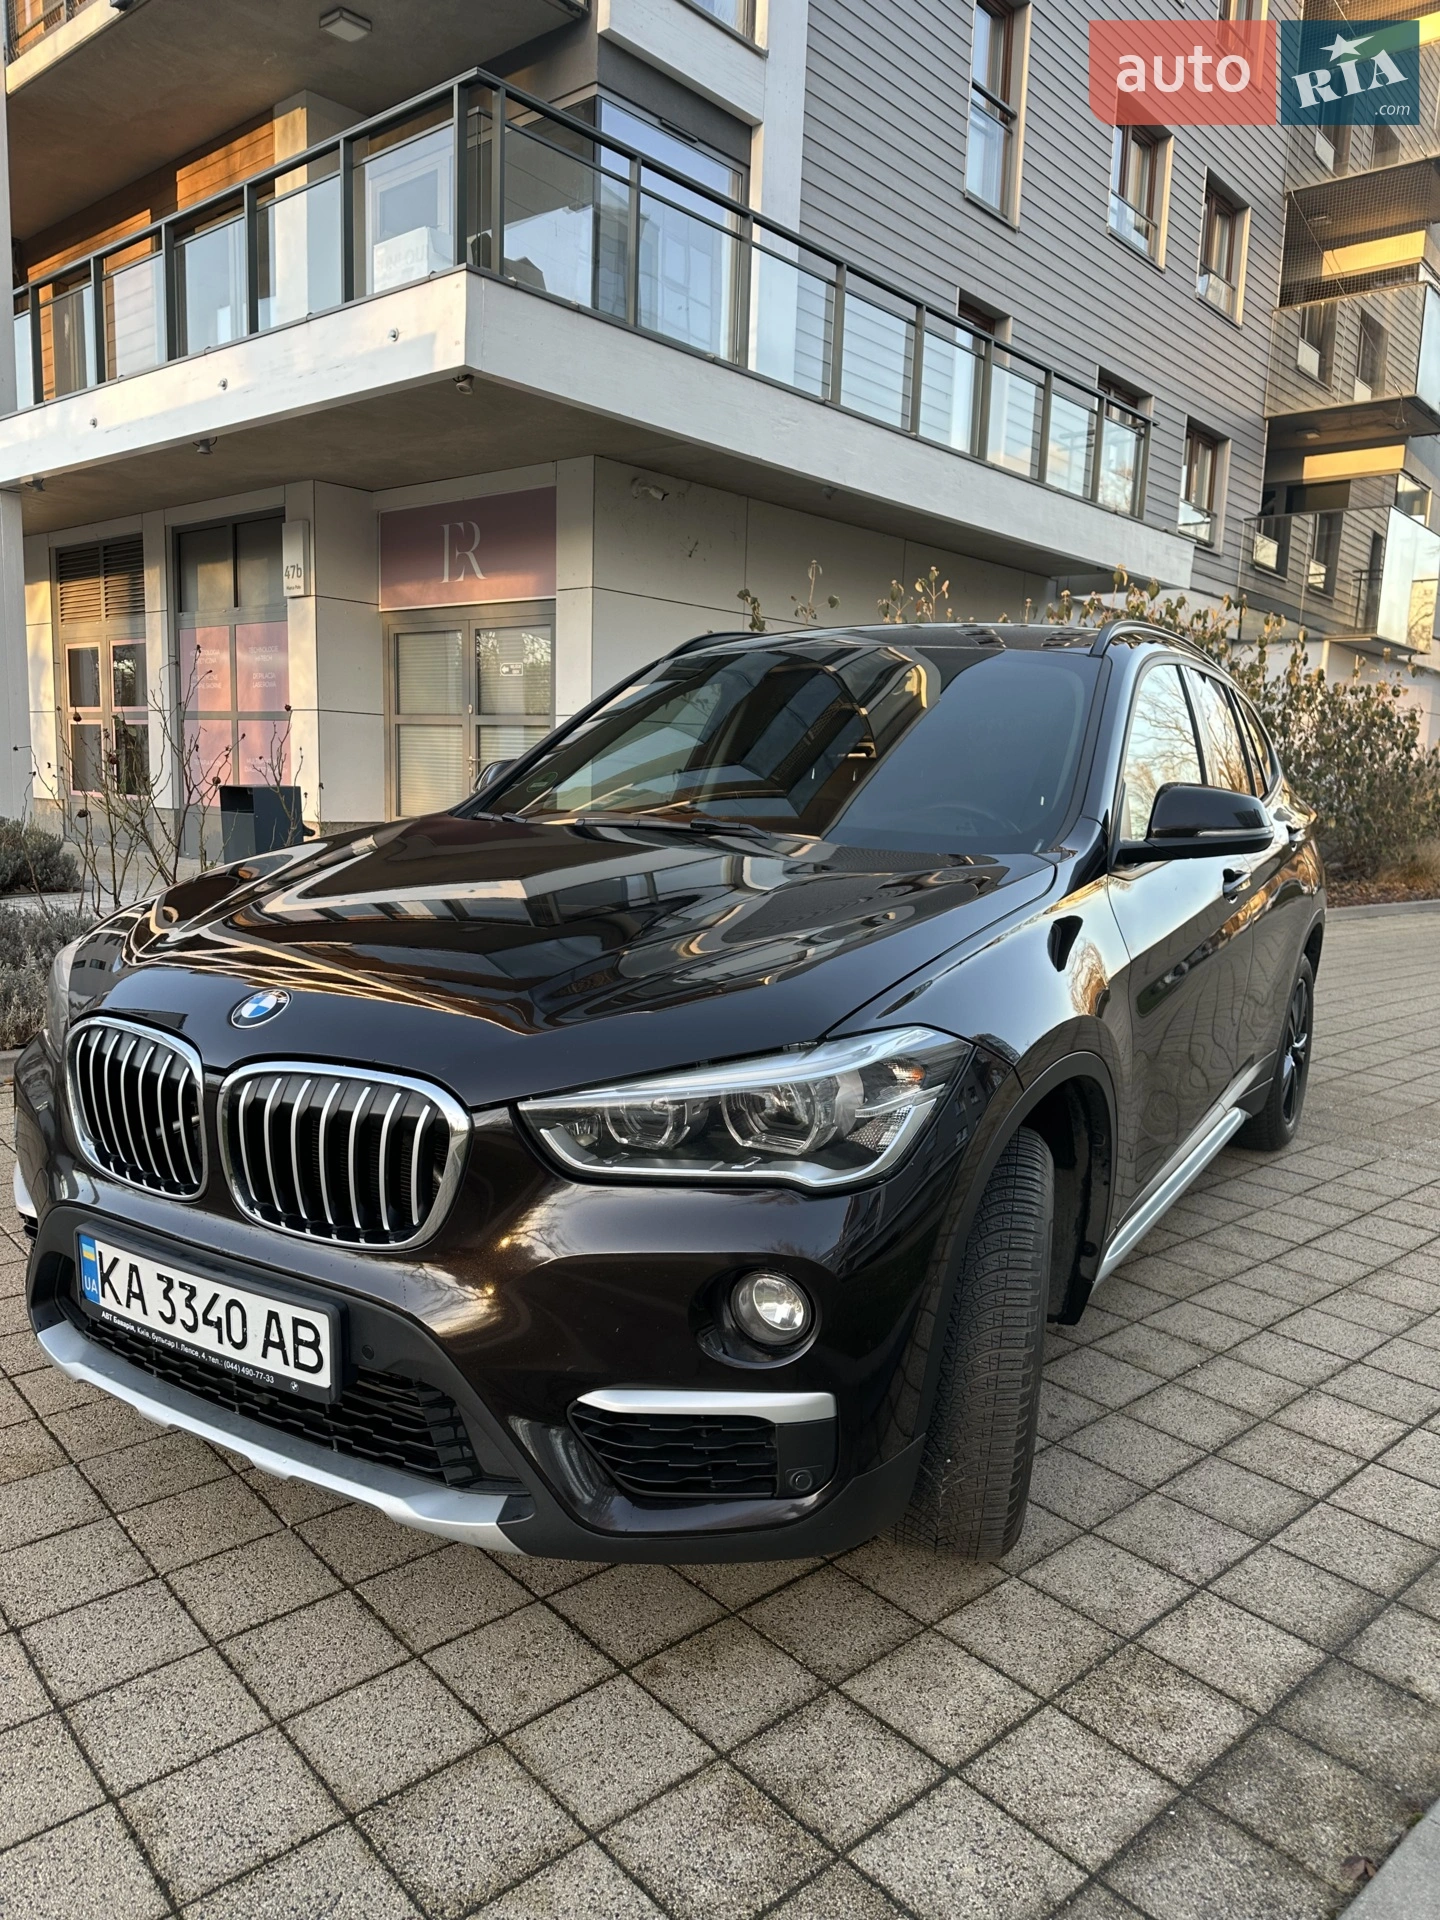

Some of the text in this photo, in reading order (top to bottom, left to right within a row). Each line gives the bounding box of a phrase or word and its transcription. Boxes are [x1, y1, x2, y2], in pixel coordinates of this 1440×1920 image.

[284, 563, 302, 580] 47b
[84, 1275, 98, 1295] UA
[98, 1250, 324, 1374] KA 3340 AB
[223, 1360, 241, 1374] (044)
[241, 1366, 275, 1384] 490-77-33
